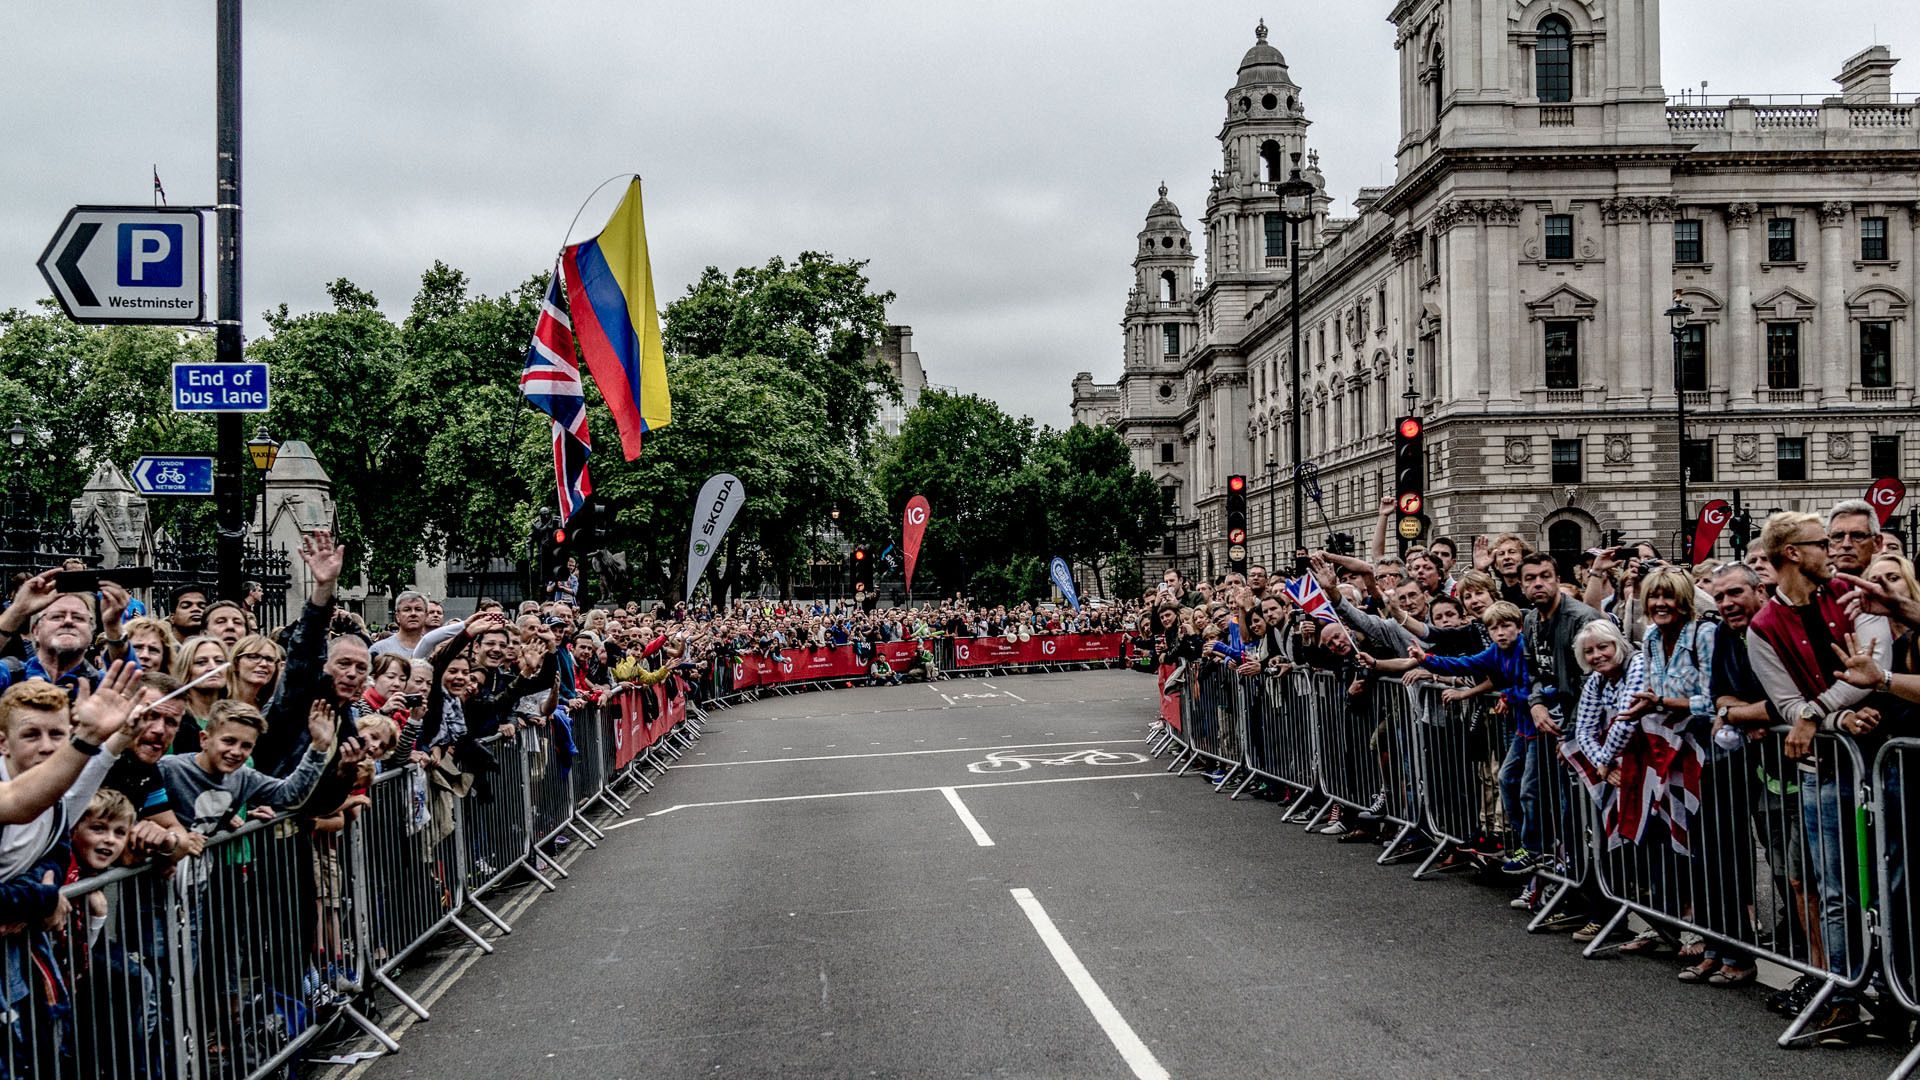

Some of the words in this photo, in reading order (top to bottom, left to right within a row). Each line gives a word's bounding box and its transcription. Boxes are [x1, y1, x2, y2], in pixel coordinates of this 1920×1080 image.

[130, 229, 171, 281] P
[108, 296, 194, 309] Westminster
[188, 370, 224, 386] End
[232, 370, 253, 386] of
[179, 388, 214, 404] bus
[222, 388, 264, 404] lane
[1872, 487, 1897, 505] IG
[702, 480, 735, 536] ŠKODA
[907, 507, 925, 525] IG
[1704, 509, 1725, 524] IG
[956, 645, 970, 660] IG
[1042, 640, 1056, 654] IG
[733, 663, 744, 681] IG
